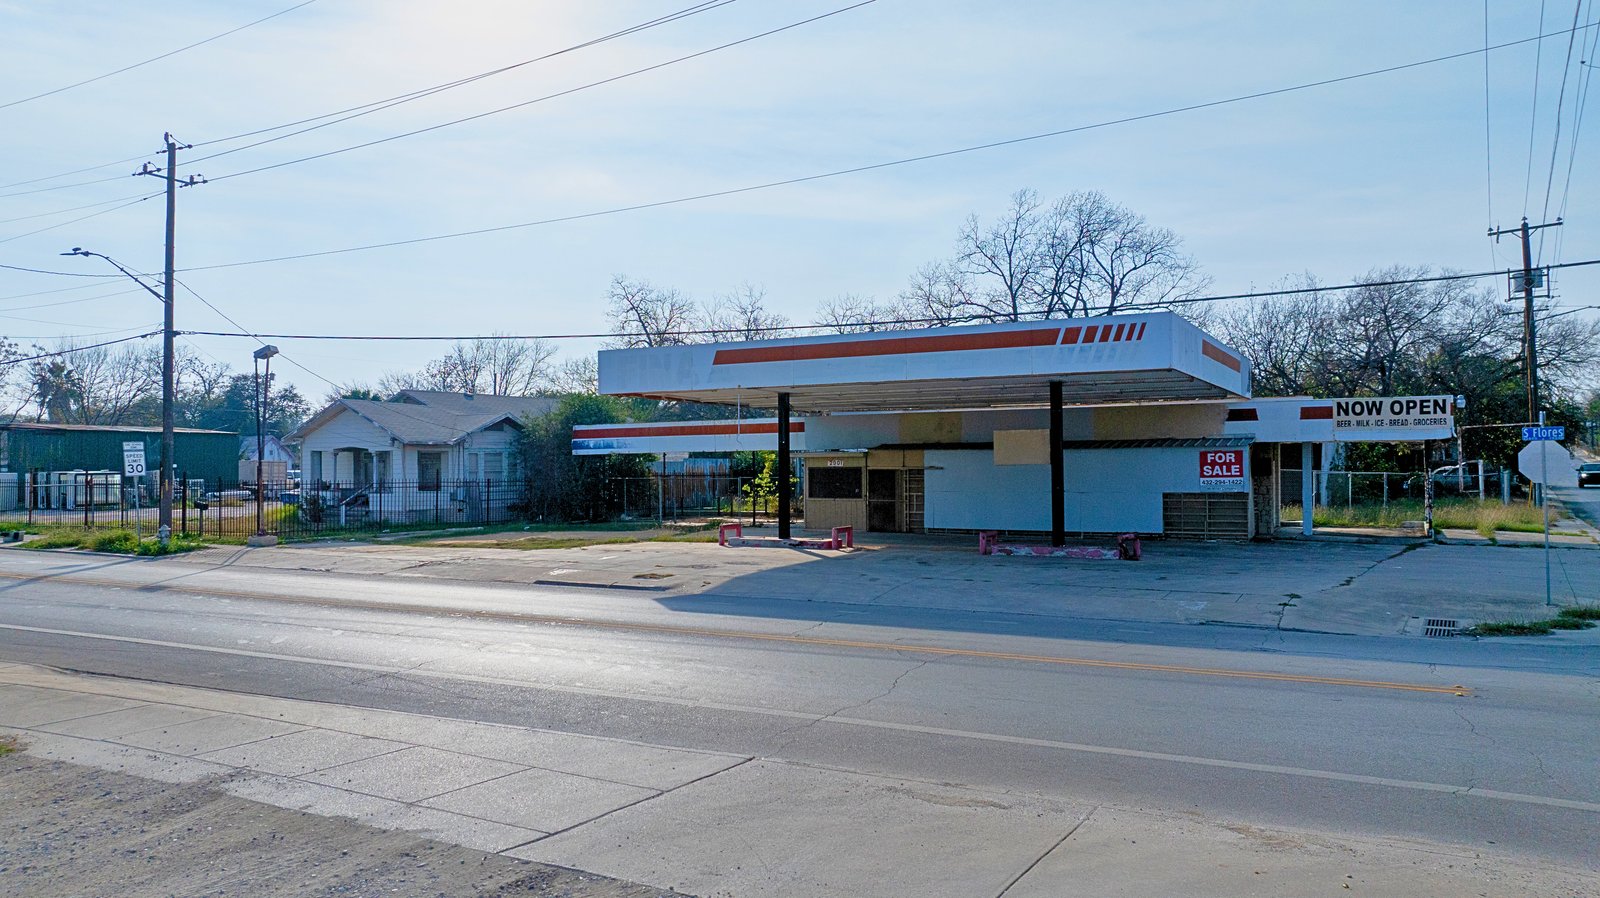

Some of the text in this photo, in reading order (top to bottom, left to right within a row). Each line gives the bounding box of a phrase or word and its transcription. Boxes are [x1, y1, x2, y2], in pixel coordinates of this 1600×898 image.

[1336, 400, 1446, 416] NOW OPEN
[1413, 418, 1447, 426] GROCERIES
[1524, 428, 1564, 438] S Flores
[1208, 453, 1236, 462] FOR
[128, 464, 143, 473] 30
[1203, 465, 1240, 476] SALE
